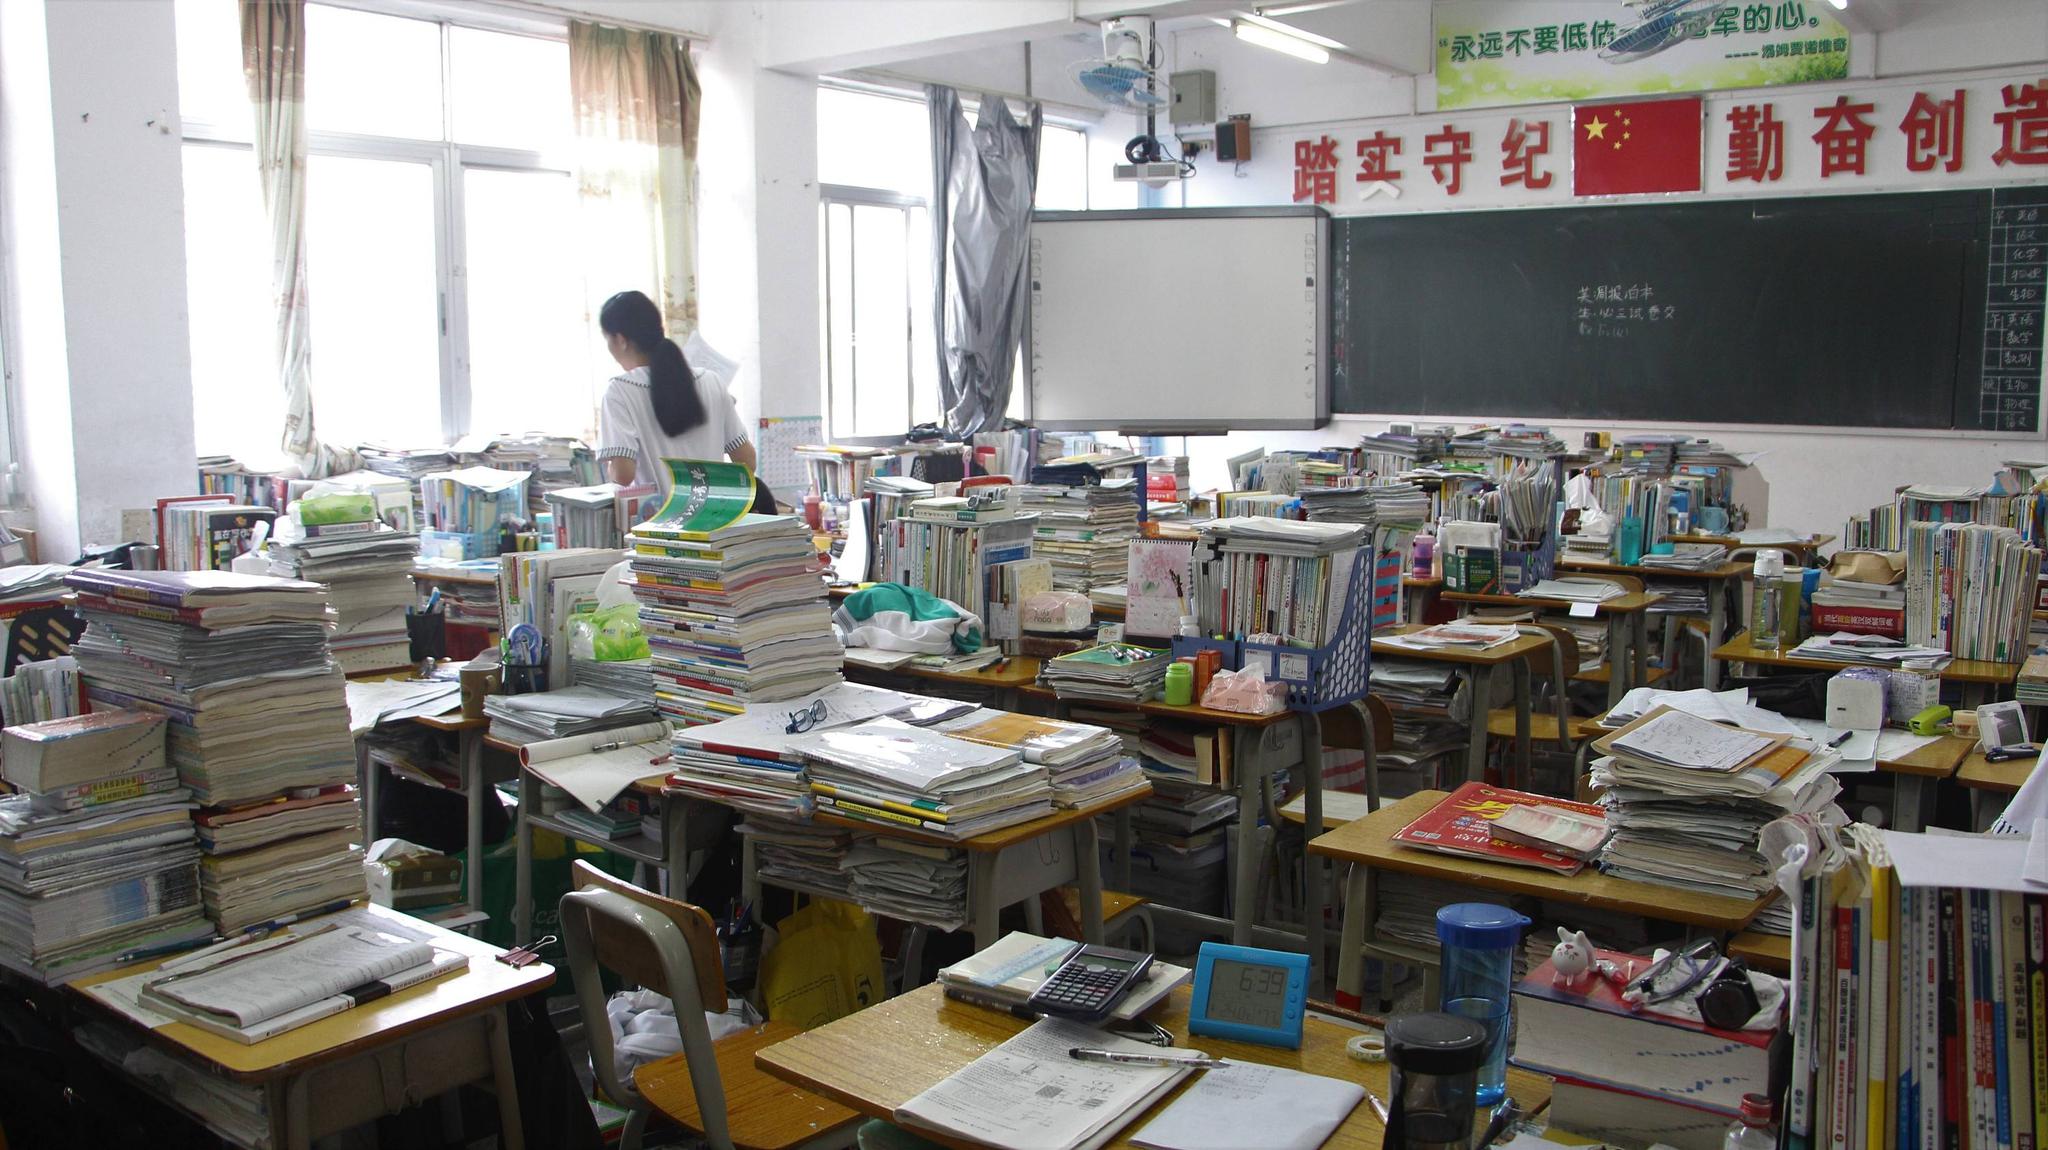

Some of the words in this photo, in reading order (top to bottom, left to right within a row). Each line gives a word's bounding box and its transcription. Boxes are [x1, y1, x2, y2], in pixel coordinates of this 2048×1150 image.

[1292, 118, 1553, 205] 踏实守纪
[1725, 79, 2048, 183] 勤奋创造
[1239, 966, 1285, 996] 6:39
